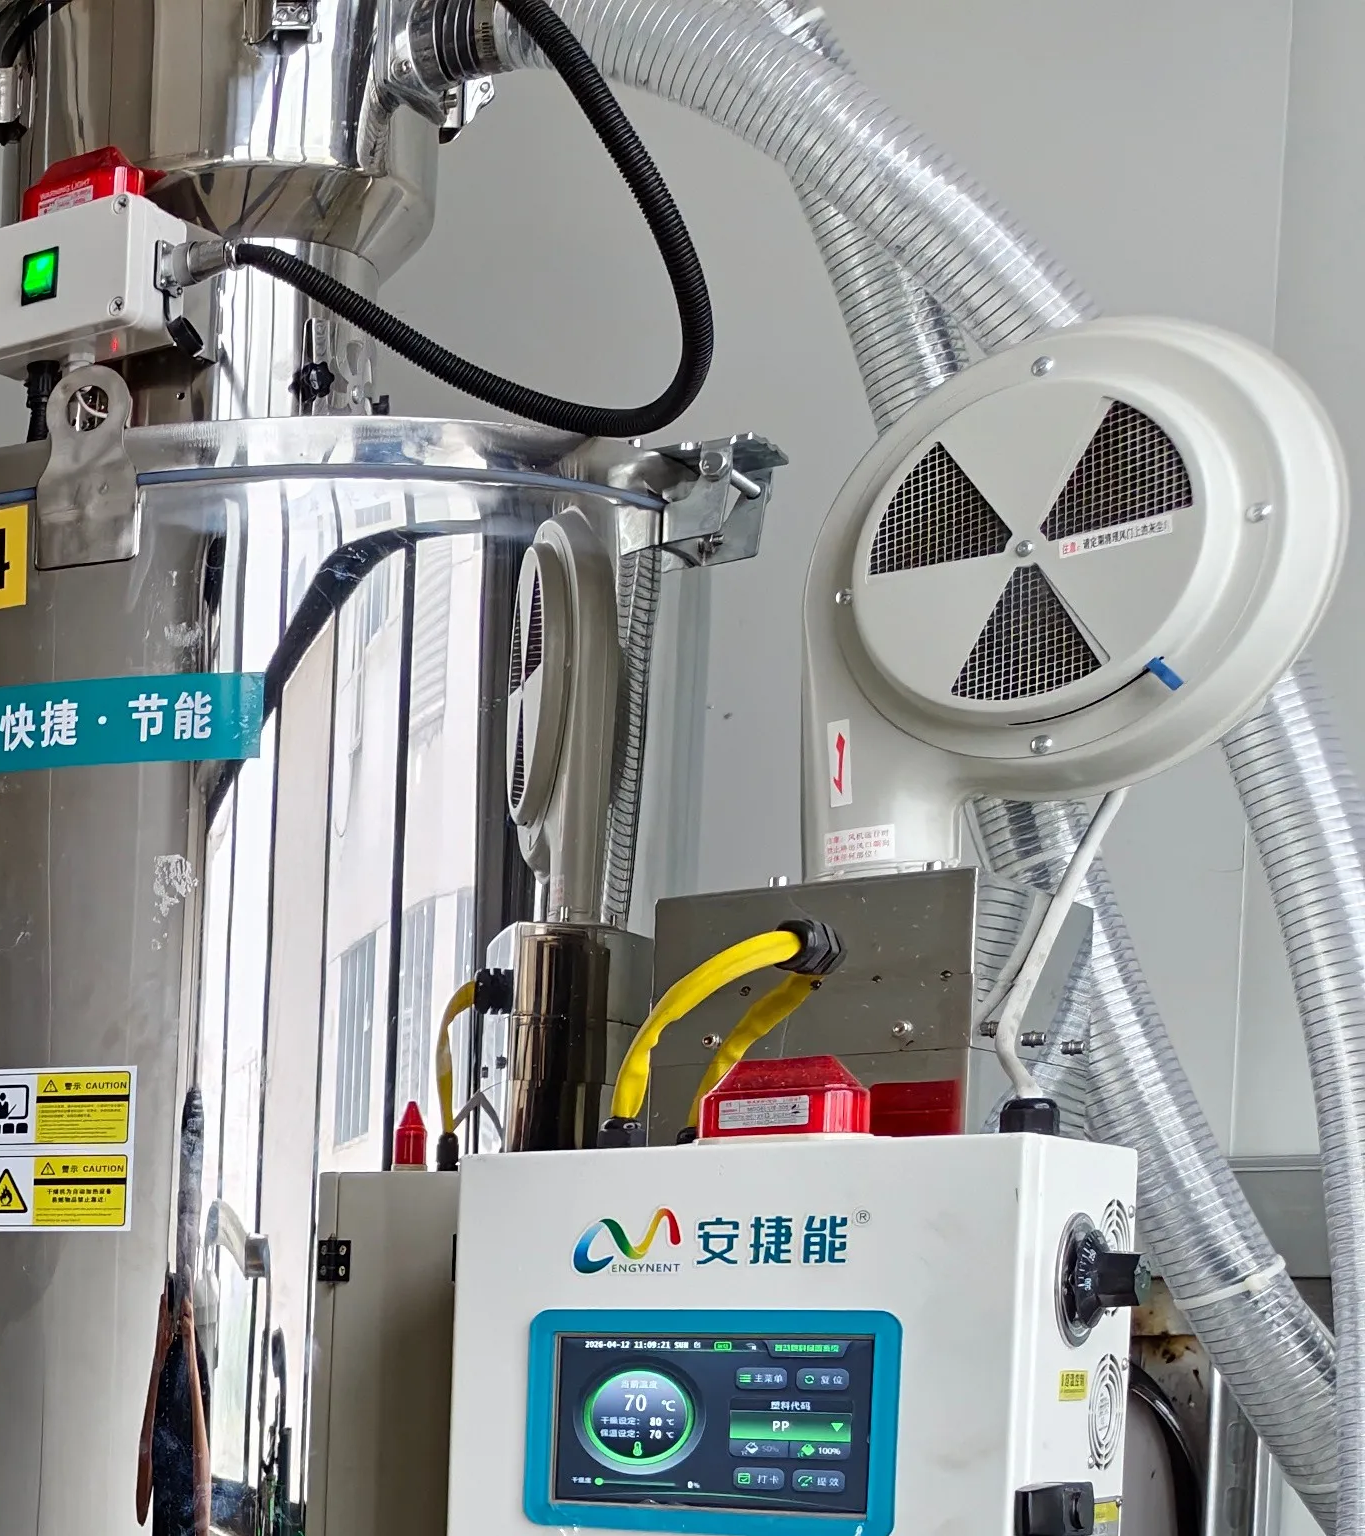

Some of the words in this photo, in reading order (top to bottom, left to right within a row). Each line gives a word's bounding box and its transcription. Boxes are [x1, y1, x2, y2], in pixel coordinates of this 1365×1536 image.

[85, 1082, 127, 1090] CAUTION
[82, 1165, 124, 1173] CAUTION
[696, 1214, 848, 1265] 安捷能
[611, 1262, 681, 1273] ENGYNENT
[624, 1393, 647, 1412] 70
[771, 1419, 791, 1432] PP
[648, 1428, 663, 1440] 70
[818, 1445, 842, 1456] 100%
